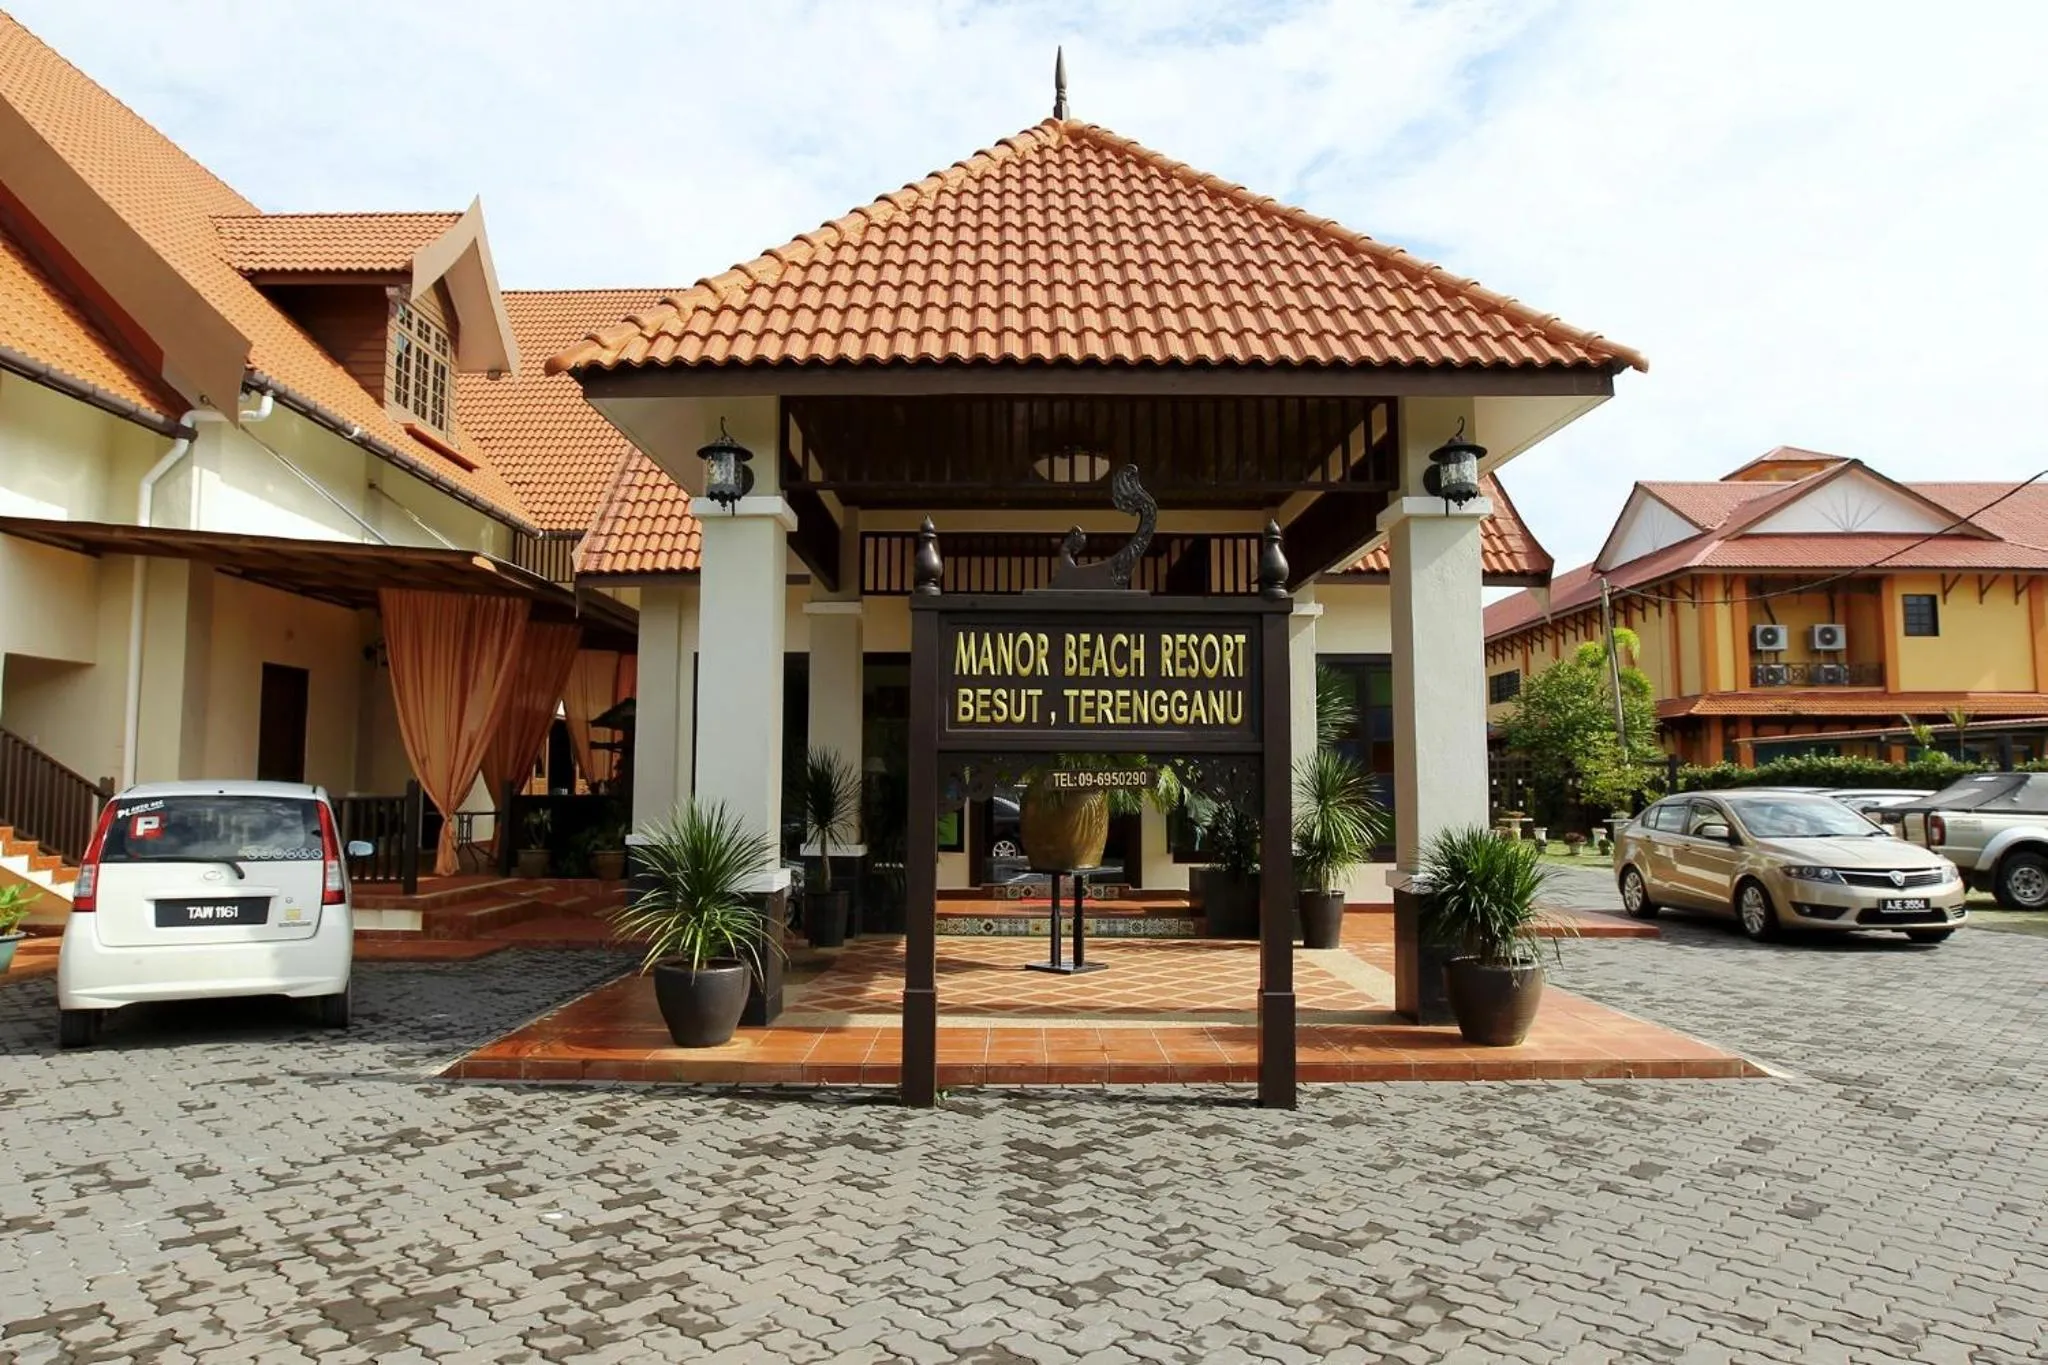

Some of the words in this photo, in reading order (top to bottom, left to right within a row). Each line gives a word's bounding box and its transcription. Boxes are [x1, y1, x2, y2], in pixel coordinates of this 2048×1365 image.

[954, 631, 1049, 677] MANOR
[1064, 633, 1145, 678] BEACH
[1160, 633, 1246, 678] RESORT
[957, 688, 1043, 723] BESUT
[1063, 689, 1243, 725] TERENGGANU
[136, 816, 160, 836] P
[186, 906, 213, 919] TAW
[215, 905, 239, 919] 1161
[1886, 900, 1903, 910] AJE
